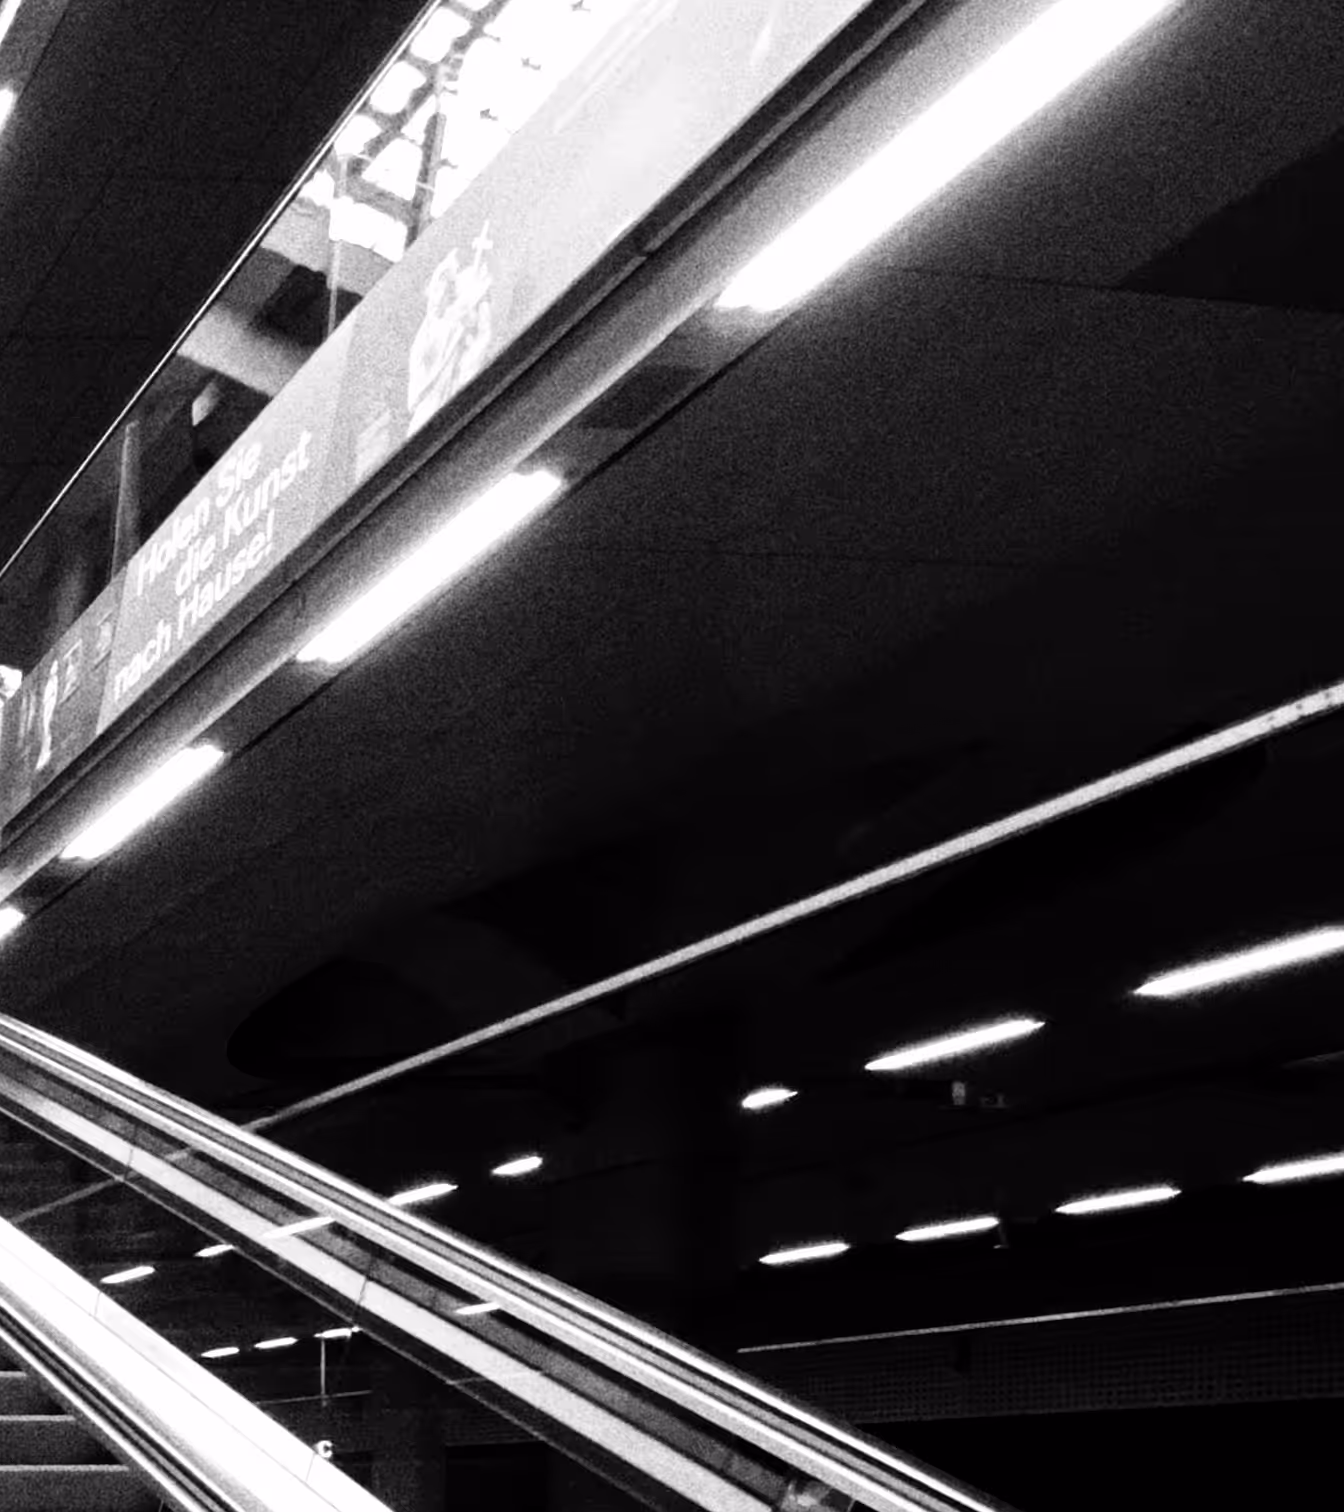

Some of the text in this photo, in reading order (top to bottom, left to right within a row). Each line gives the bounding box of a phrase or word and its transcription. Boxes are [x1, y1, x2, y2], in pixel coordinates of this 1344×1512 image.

[136, 442, 262, 597] Holen Sie
[175, 430, 312, 597] die Kunst
[113, 507, 275, 702] nach Hause!
[317, 1440, 333, 1459] C
